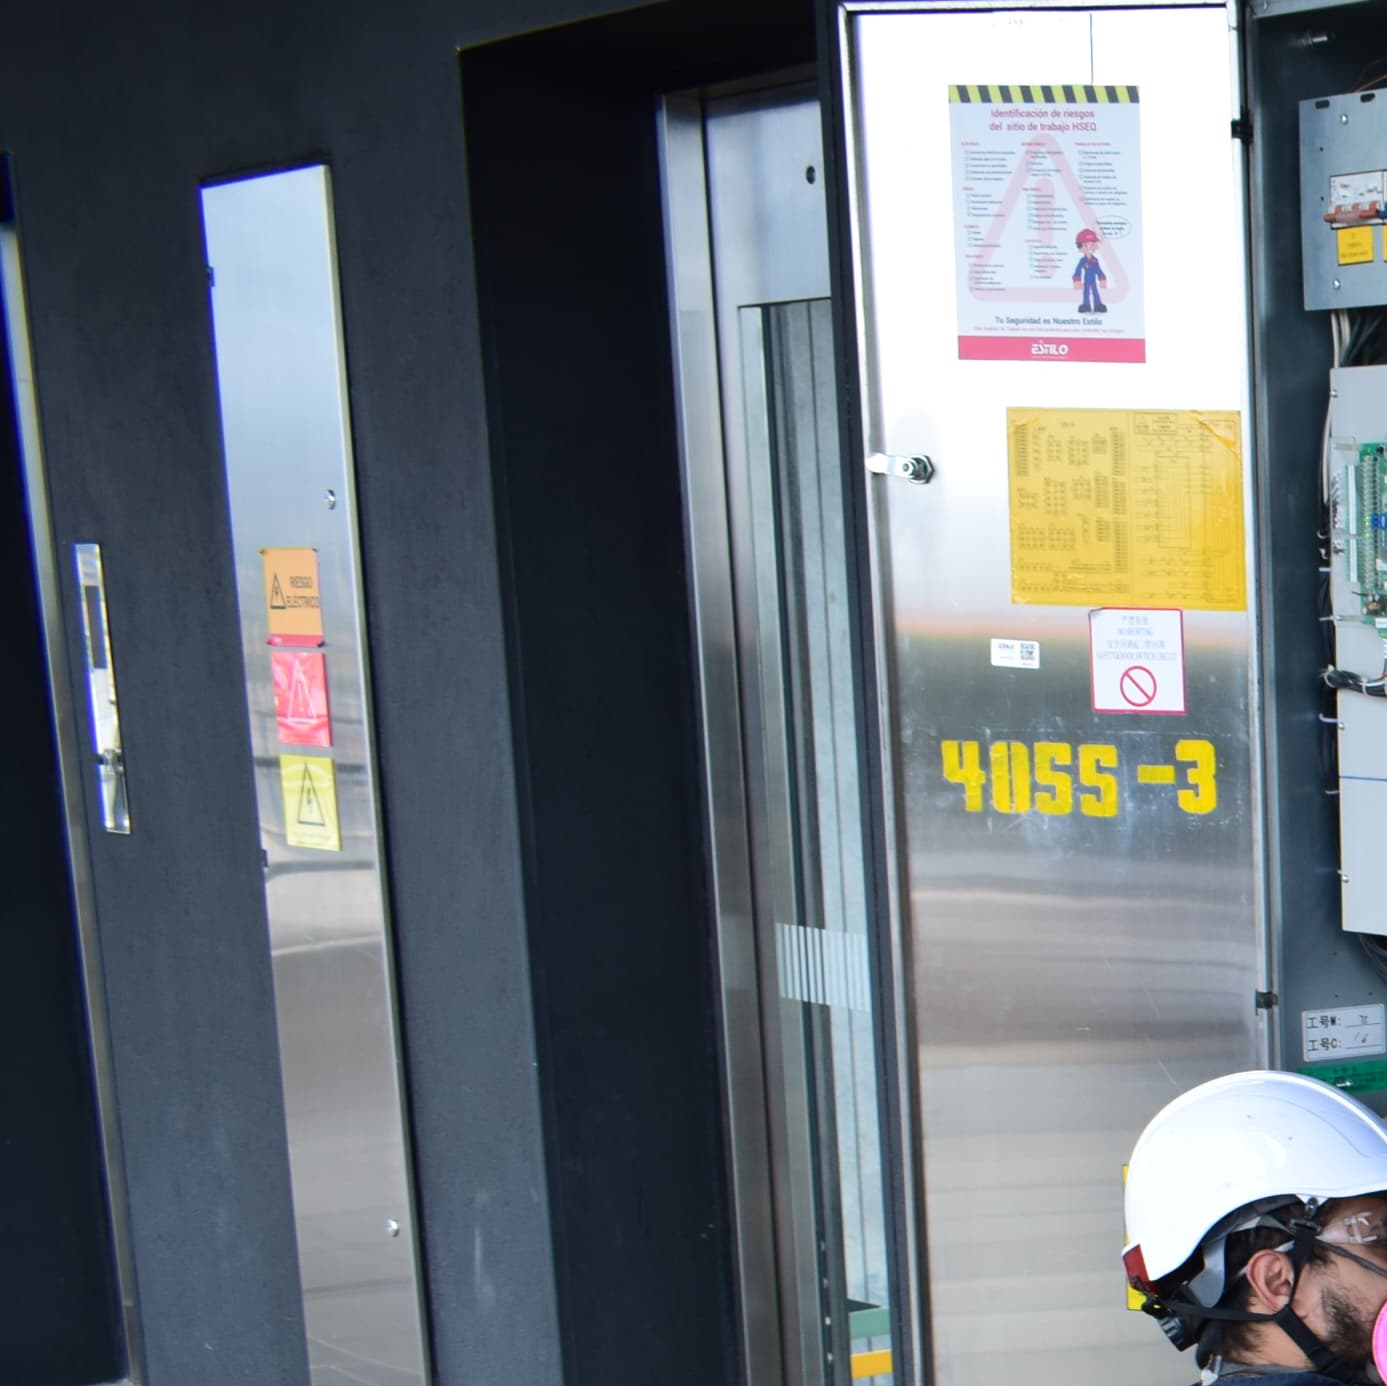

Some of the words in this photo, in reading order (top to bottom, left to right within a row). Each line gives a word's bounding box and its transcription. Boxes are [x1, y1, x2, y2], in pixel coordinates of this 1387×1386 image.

[991, 107, 1048, 118] Identificación
[1050, 108, 1061, 118] de
[1063, 110, 1095, 120] riesgos
[989, 121, 1002, 131] del
[1007, 122, 1026, 131] sitio
[1027, 122, 1038, 131] de
[1040, 122, 1070, 134] trabajo
[1006, 316, 1041, 326] Seguridad
[1053, 317, 1081, 325] Nuestro
[1031, 342, 1069, 355] ESTILO
